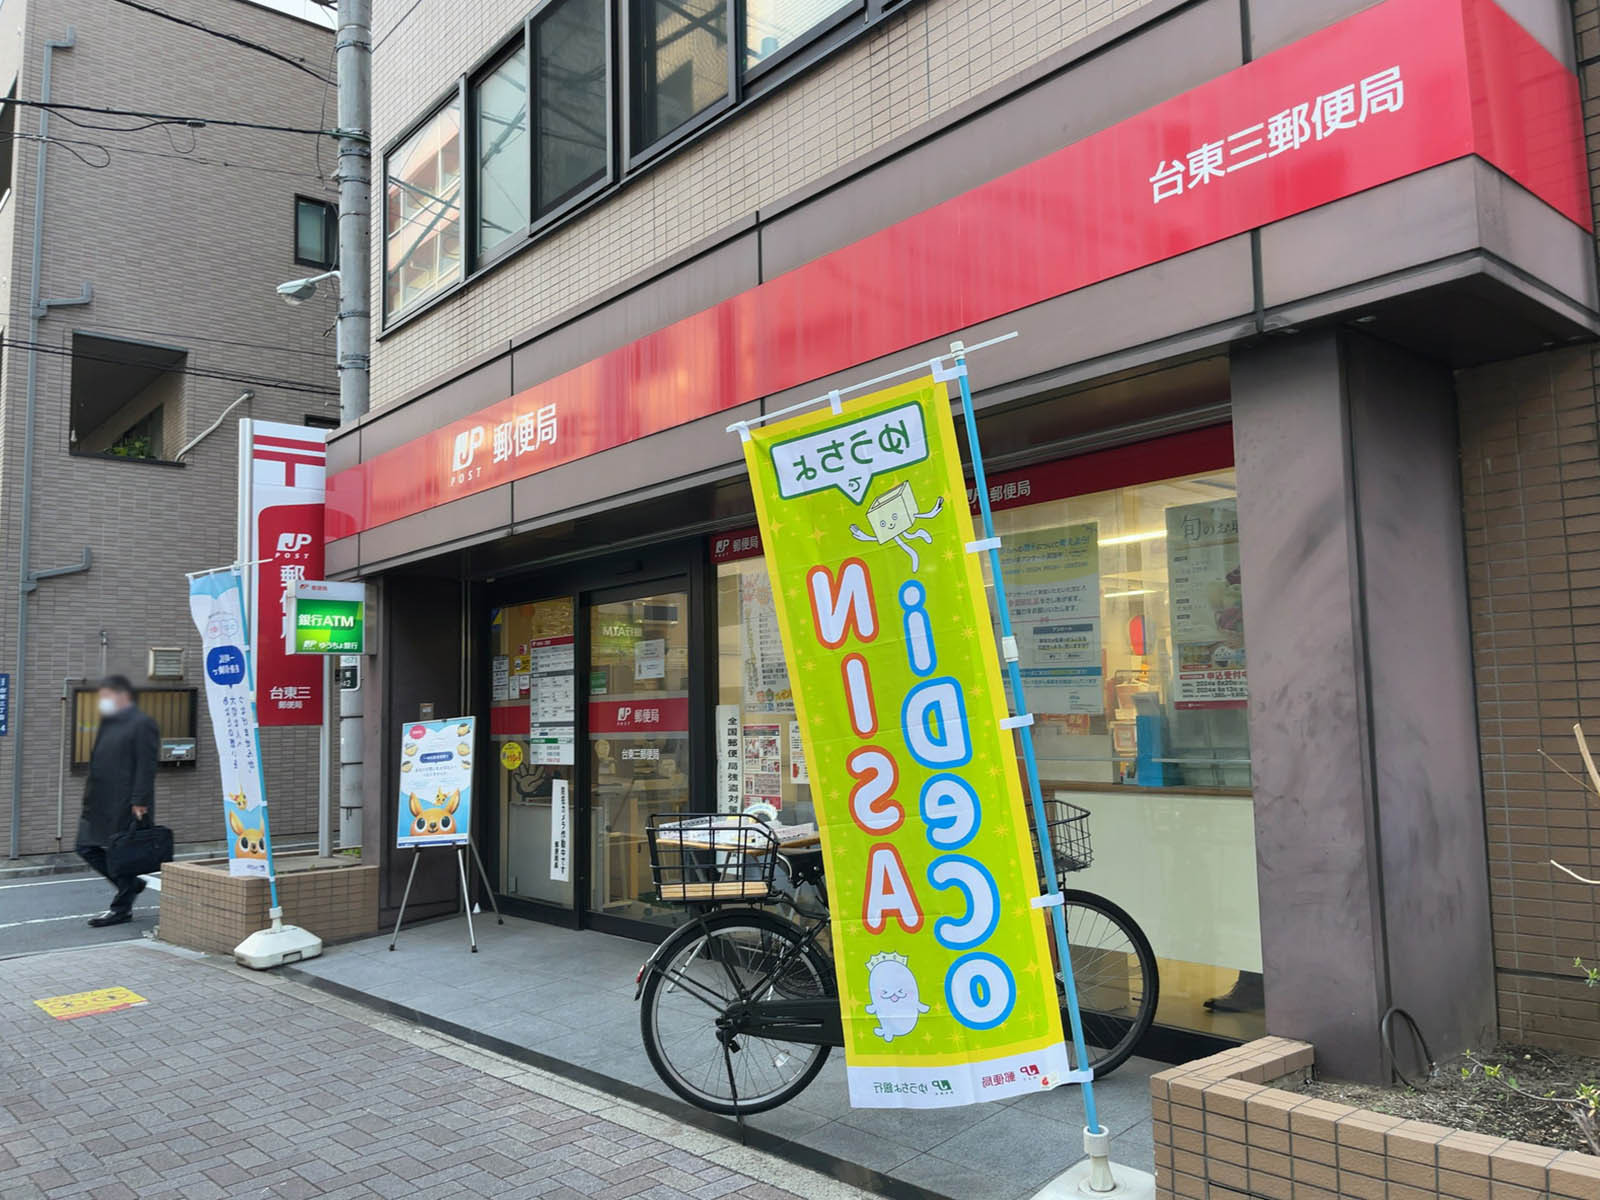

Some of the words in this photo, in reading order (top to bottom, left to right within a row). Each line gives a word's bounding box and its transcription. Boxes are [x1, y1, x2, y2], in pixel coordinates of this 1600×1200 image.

[1149, 65, 1404, 204] 台東三郵便局
[492, 402, 558, 464] 郵便局
[990, 480, 1031, 502] 郵便局
[276, 532, 312, 552] JP
[732, 535, 759, 553] 郵便局
[298, 613, 355, 628] 銀行ATM
[319, 642, 358, 650] ゆうちょ銀行
[269, 686, 311, 700] 台東三
[278, 700, 303, 709] 郵便局
[634, 708, 660, 723] 郵便局
[622, 749, 660, 760] 台東三郵便局
